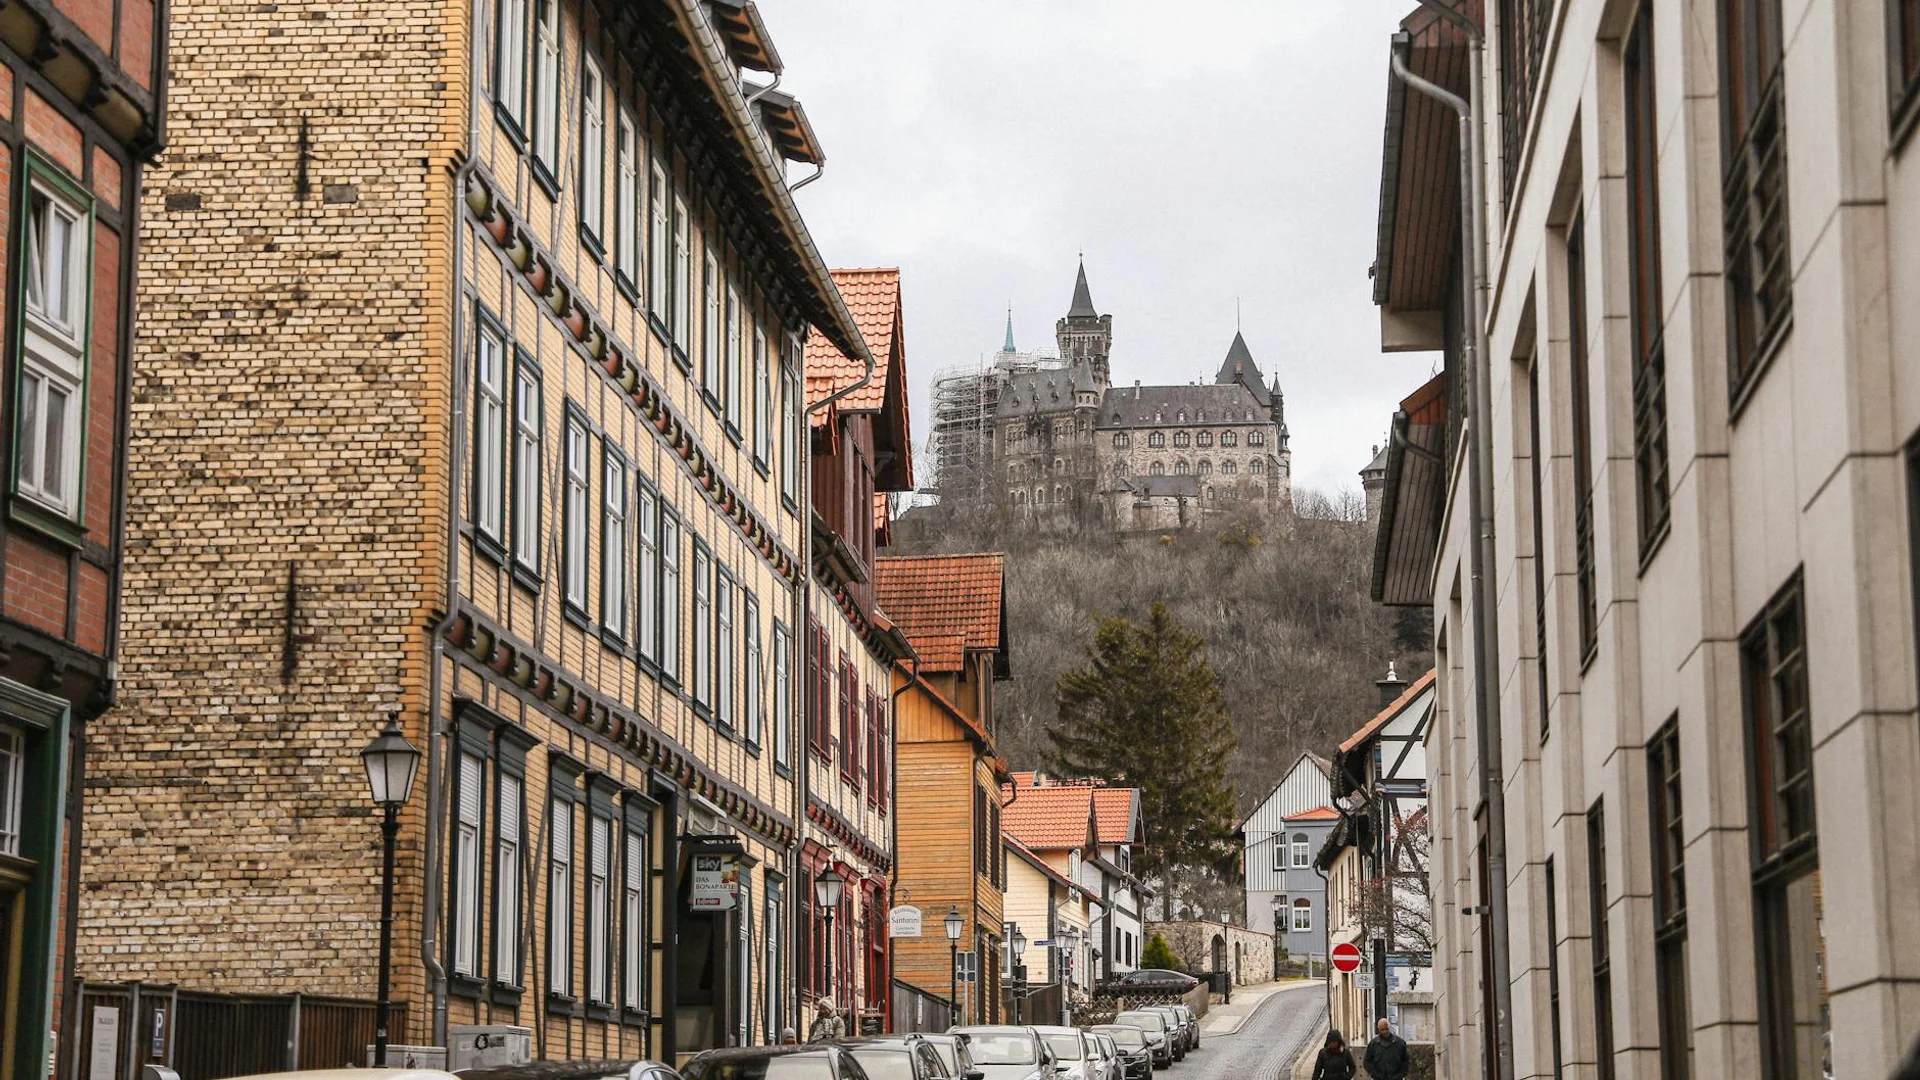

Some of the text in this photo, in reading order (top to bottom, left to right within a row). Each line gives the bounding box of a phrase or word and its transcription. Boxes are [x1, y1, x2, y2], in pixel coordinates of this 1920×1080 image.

[698, 857, 720, 870] sky
[891, 916, 920, 924] Santorini
[155, 1012, 163, 1037] P
